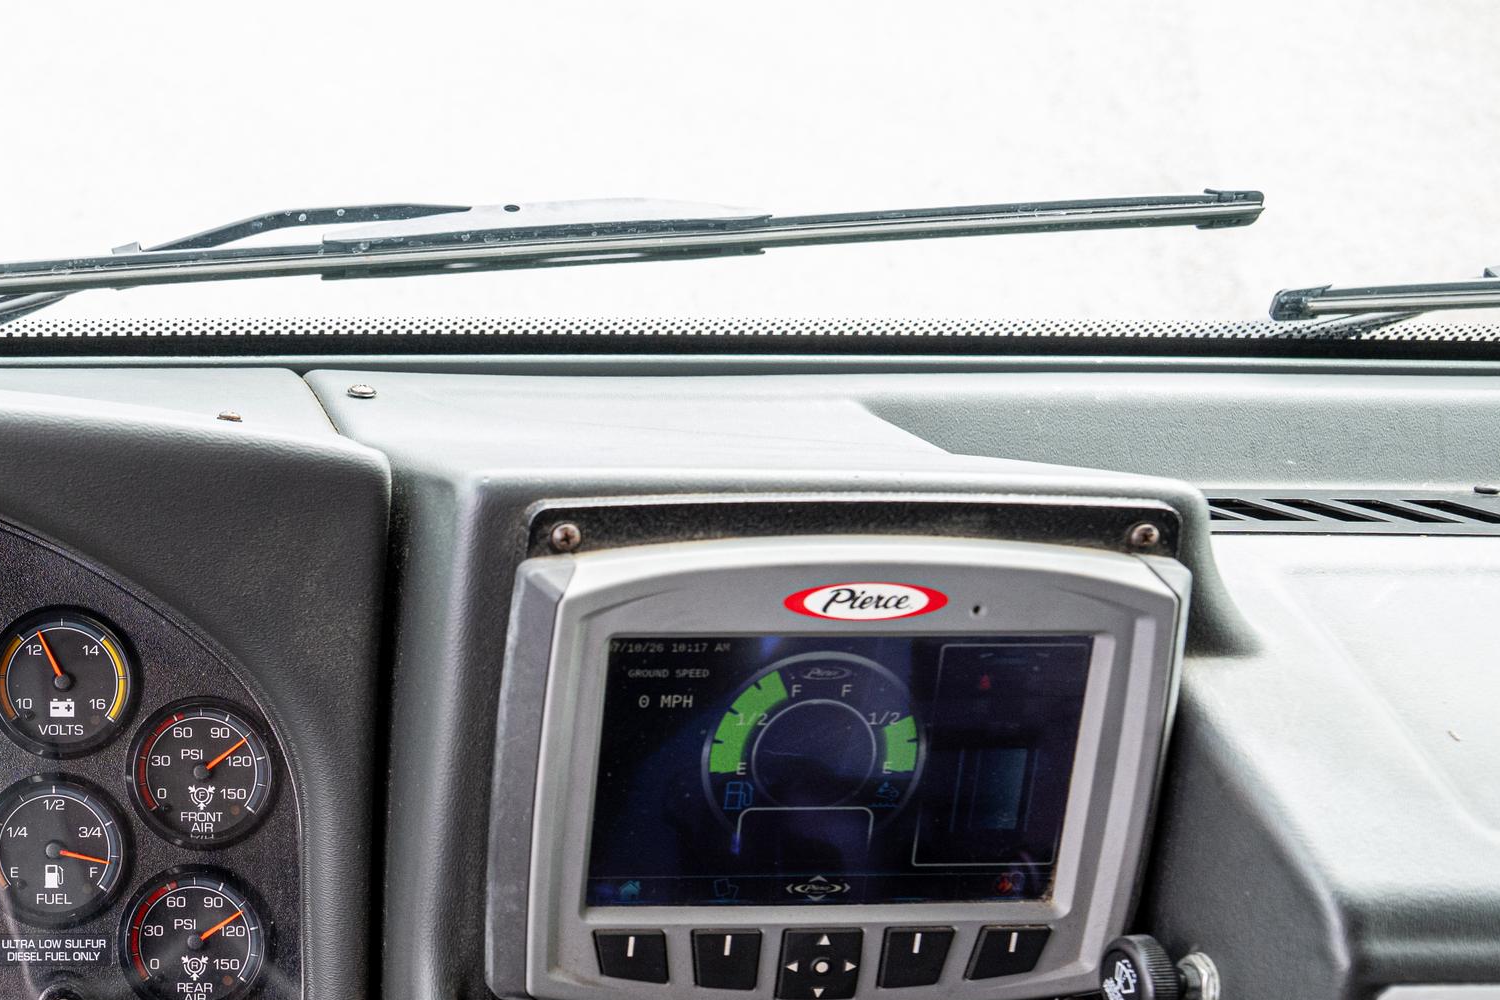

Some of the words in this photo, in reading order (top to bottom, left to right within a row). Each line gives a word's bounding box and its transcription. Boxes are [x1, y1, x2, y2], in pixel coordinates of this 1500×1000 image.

[822, 588, 913, 613] Pierce
[26, 645, 42, 655] 12
[83, 645, 99, 655] 14
[628, 669, 669, 678] GROUND
[675, 669, 709, 678] SPEED
[16, 699, 32, 709] 10
[89, 699, 105, 709] 16
[639, 695, 650, 708] 0
[660, 695, 693, 708] MPH
[38, 725, 83, 735] VOLTS
[173, 728, 192, 738] 60
[211, 728, 229, 738] 90
[181, 750, 203, 760] PSI
[152, 756, 170, 766] 30
[226, 756, 251, 766] 120
[220, 789, 246, 799] 150
[43, 800, 65, 810] 1/2
[181, 812, 223, 822] FRONT
[7, 827, 28, 838] 1/4
[79, 827, 101, 838] 3/4
[191, 823, 213, 832] AIR
[37, 894, 72, 904] FUEL
[167, 897, 185, 907] 60
[204, 897, 223, 907] 90
[174, 919, 196, 929] PSI
[144, 926, 163, 936] 30
[220, 926, 245, 937] 120
[2, 940, 35, 948] ULTRA
[39, 940, 61, 948] LOW
[65, 940, 106, 948] SULFUR
[7, 952, 42, 961] DIESEL
[45, 952, 70, 961] FUEL
[73, 952, 100, 961] ONLY
[213, 959, 239, 969] 150
[177, 983, 212, 992] REAR
